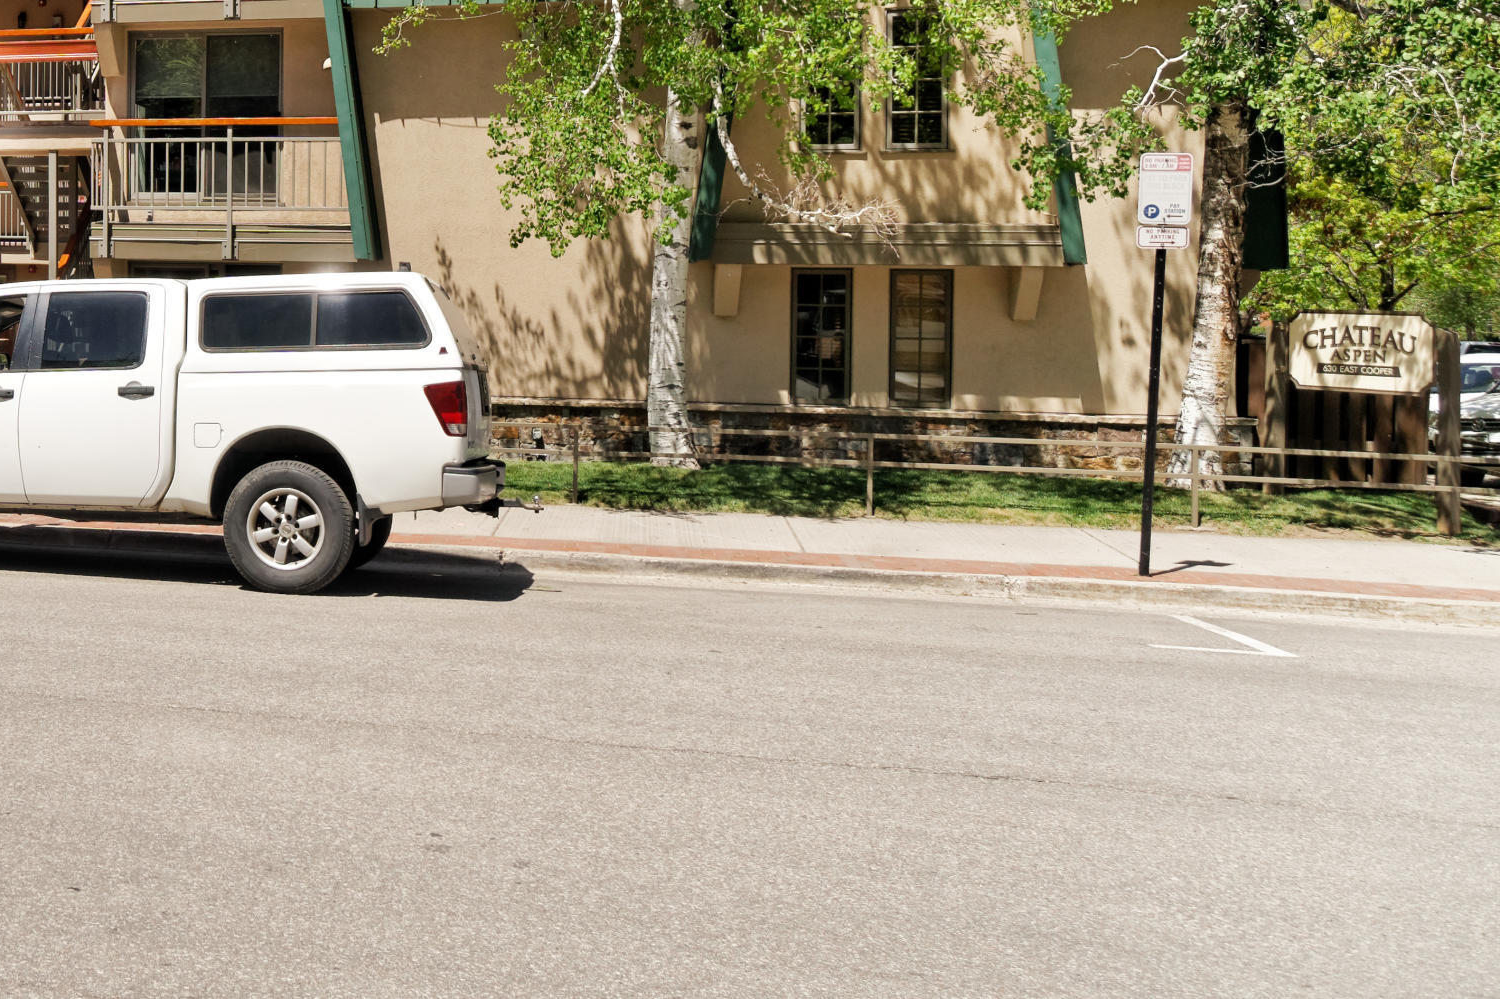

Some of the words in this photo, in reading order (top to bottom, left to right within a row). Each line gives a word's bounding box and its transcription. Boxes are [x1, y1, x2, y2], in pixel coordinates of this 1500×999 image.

[1302, 325, 1417, 356] CHATEAU
[1329, 348, 1387, 363] ASPEN
[1322, 364, 1337, 374] 630
[1339, 365, 1359, 375] EAST
[1360, 366, 1394, 376] COOPER
